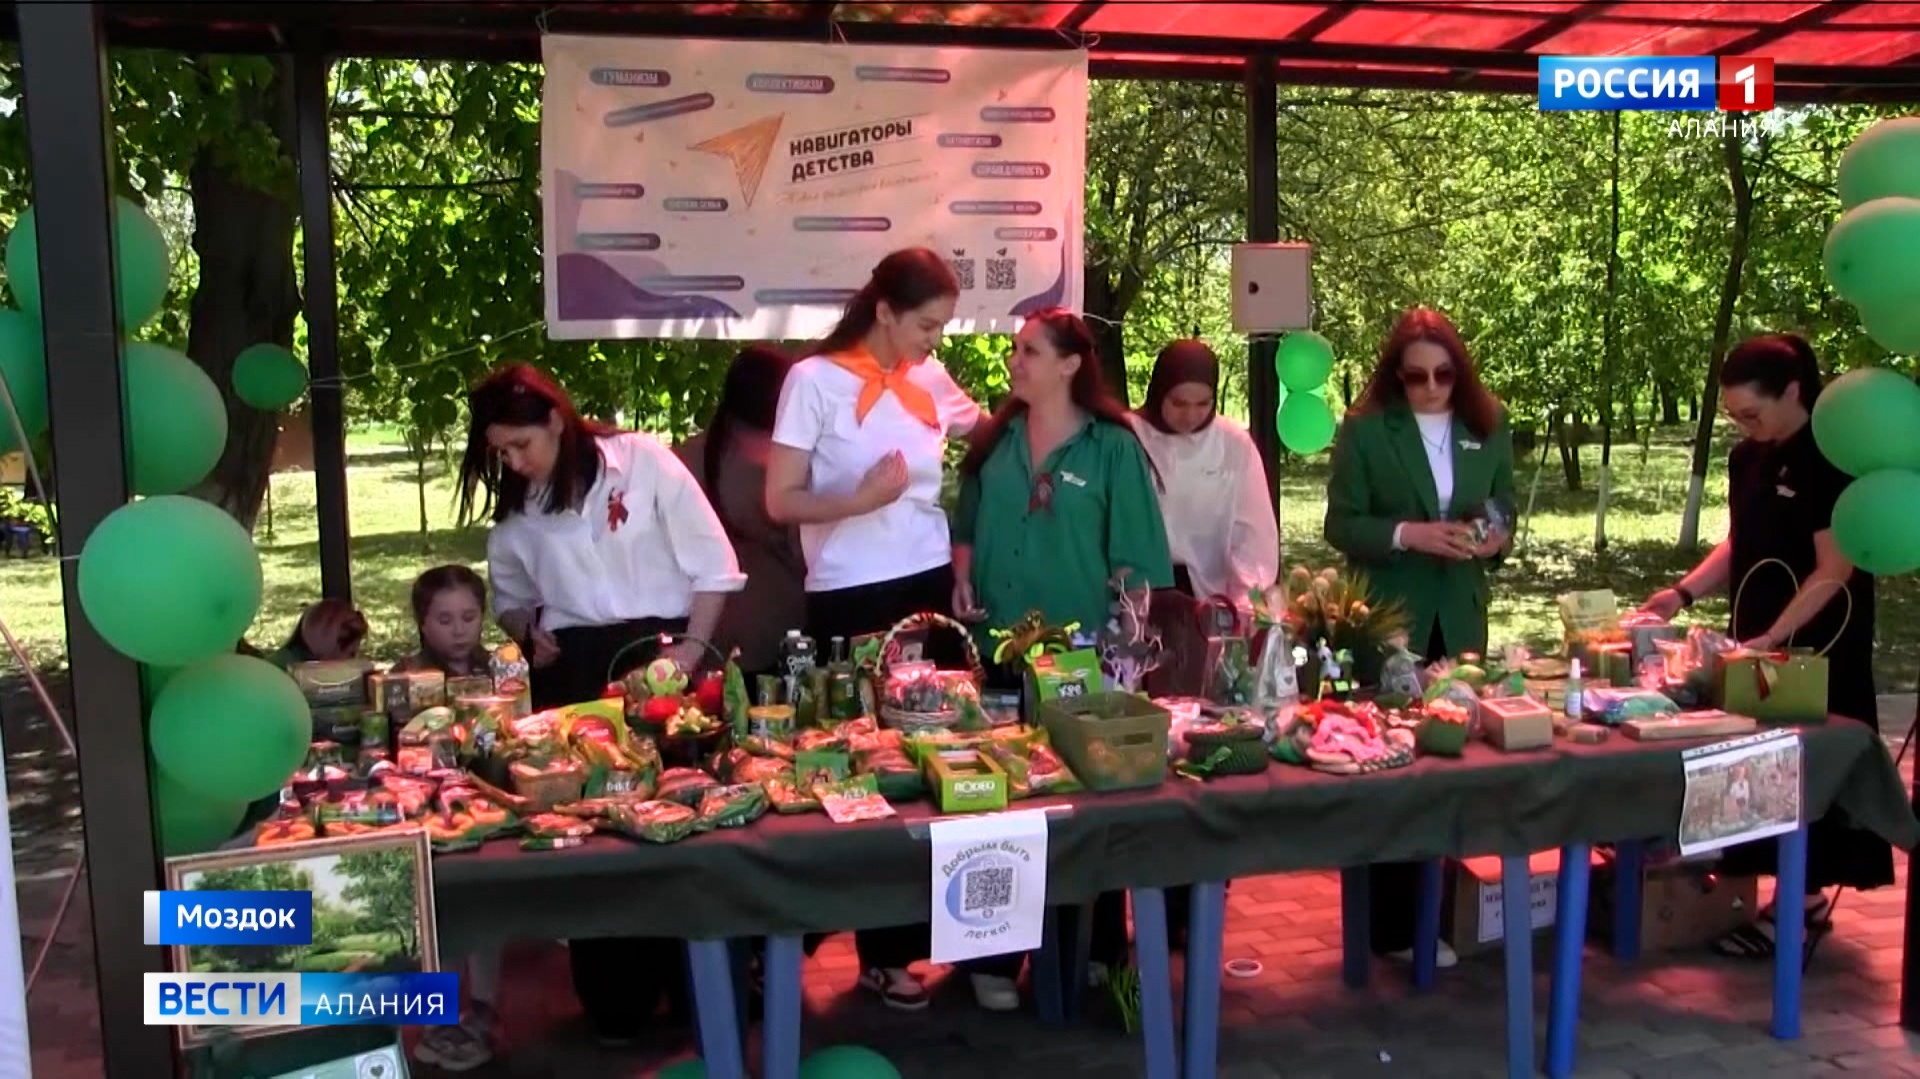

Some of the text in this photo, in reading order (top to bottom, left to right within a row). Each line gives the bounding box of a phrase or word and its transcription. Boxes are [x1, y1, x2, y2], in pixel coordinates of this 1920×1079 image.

[789, 119, 913, 156] НАВИГАТОРЫ
[791, 149, 875, 184] ДЕТСТВА
[941, 840, 1032, 878] Добрым быть
